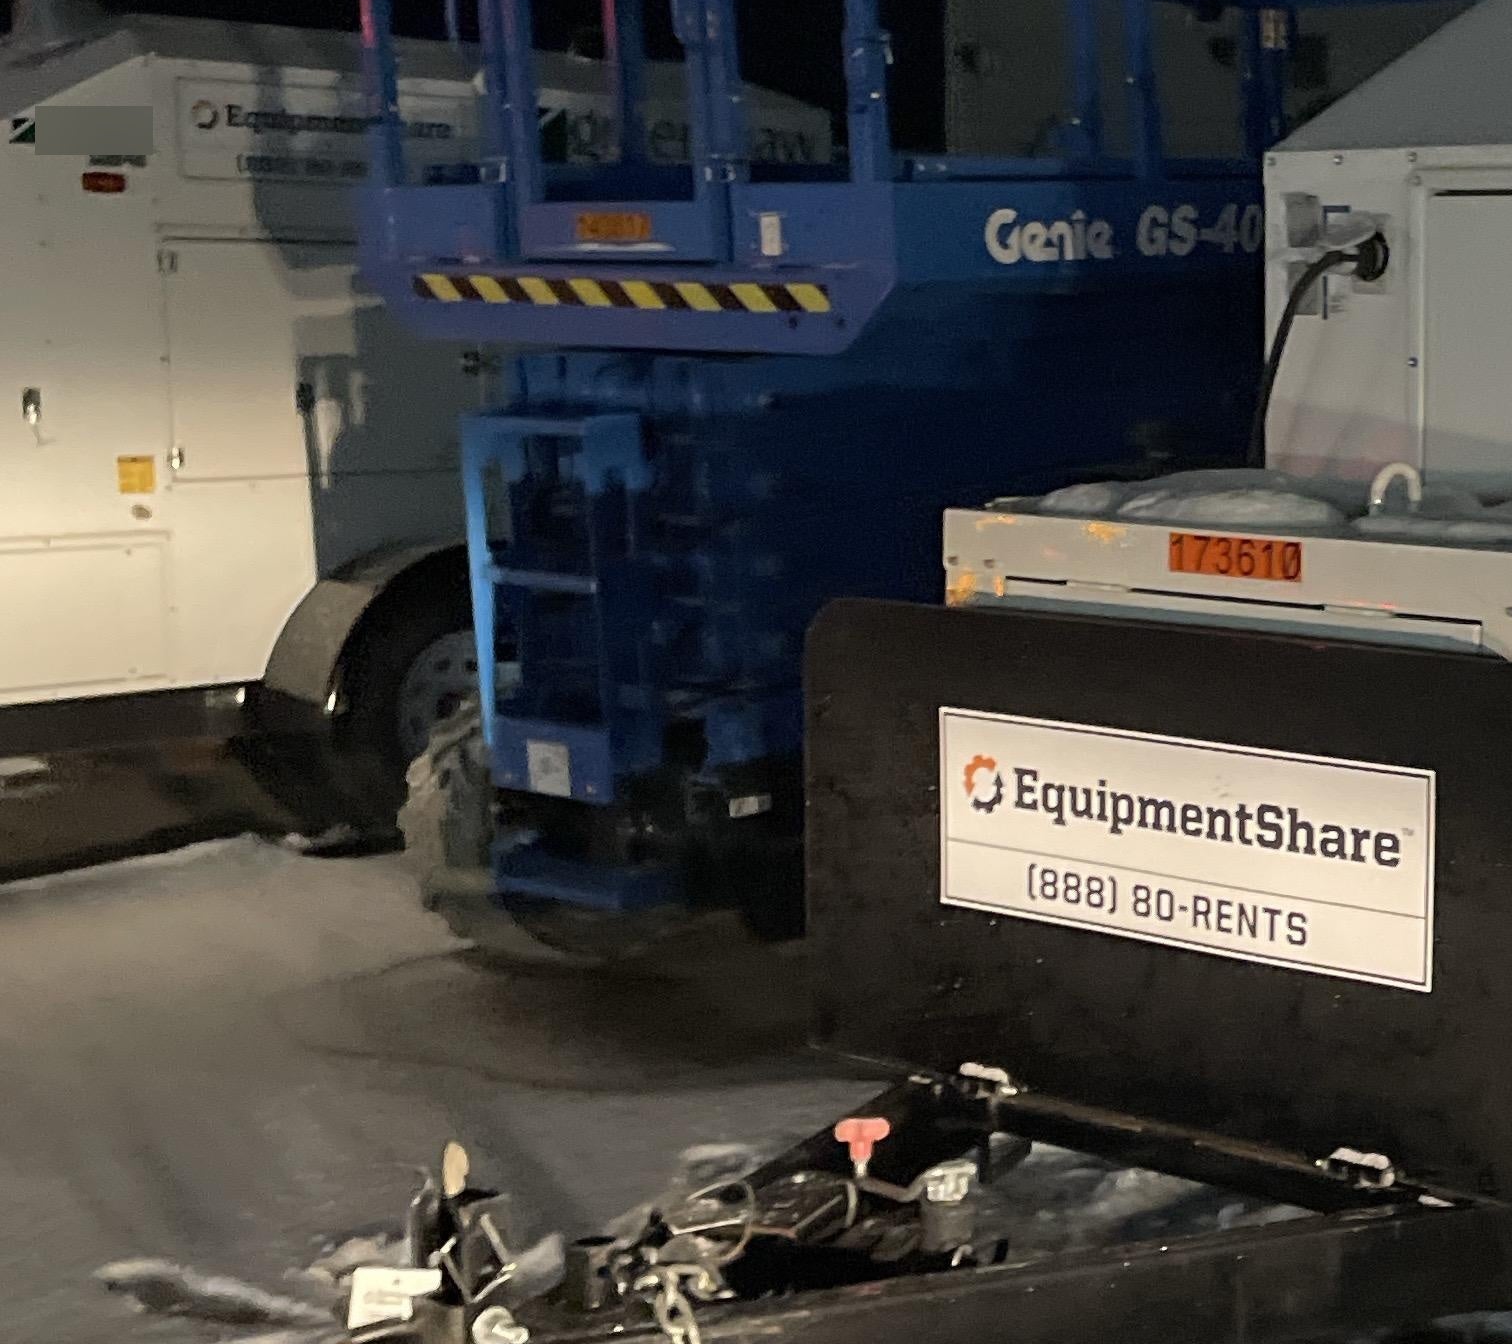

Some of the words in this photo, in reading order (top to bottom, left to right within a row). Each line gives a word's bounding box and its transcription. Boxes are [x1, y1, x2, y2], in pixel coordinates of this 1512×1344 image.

[984, 207, 1116, 265] Genie
[1135, 203, 1264, 257] GS-40
[1171, 535, 1302, 581] 173610
[1013, 767, 1402, 868] EquipmentShare
[1027, 862, 1118, 914] (888)
[1132, 885, 1308, 946] 80-RENTS
